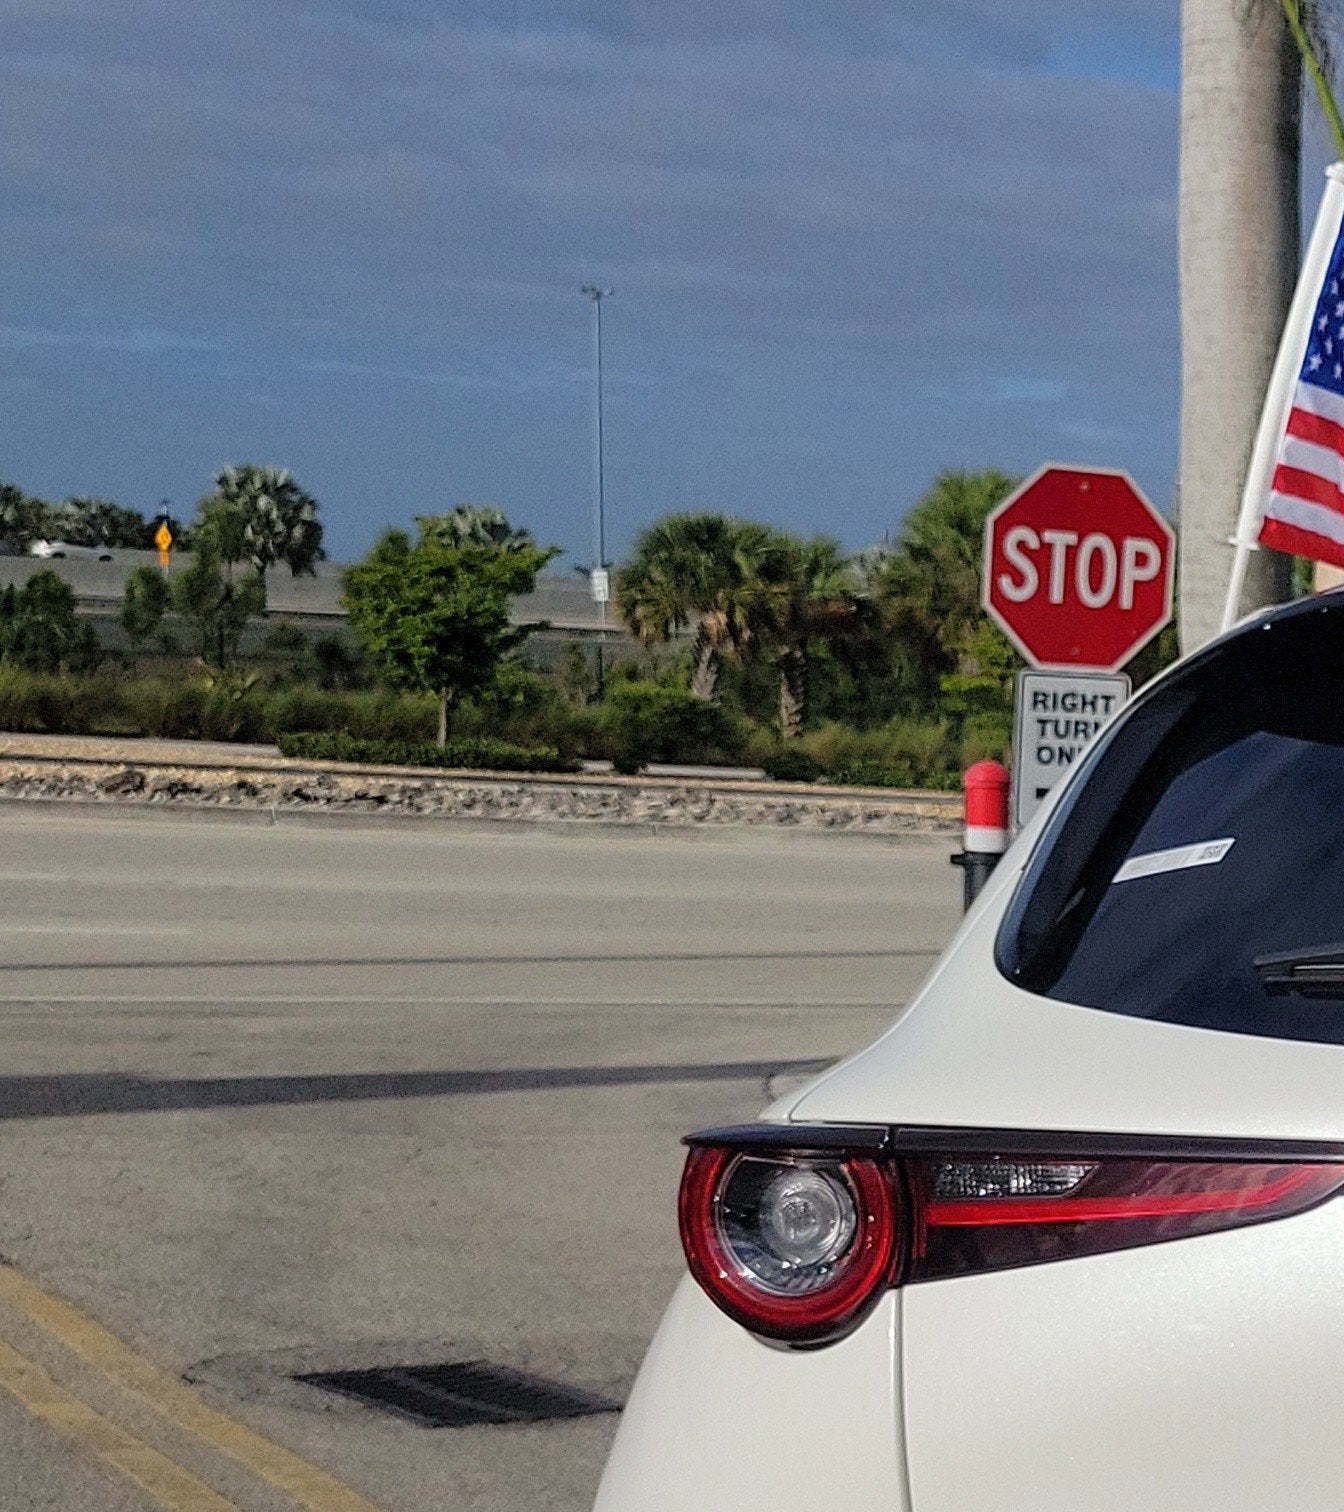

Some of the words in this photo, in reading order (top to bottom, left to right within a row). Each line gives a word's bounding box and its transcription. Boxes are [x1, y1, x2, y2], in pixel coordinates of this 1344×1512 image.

[999, 525, 1162, 610] STOP
[1032, 690, 1116, 716] RIGHT
[1036, 745, 1083, 766] ON
